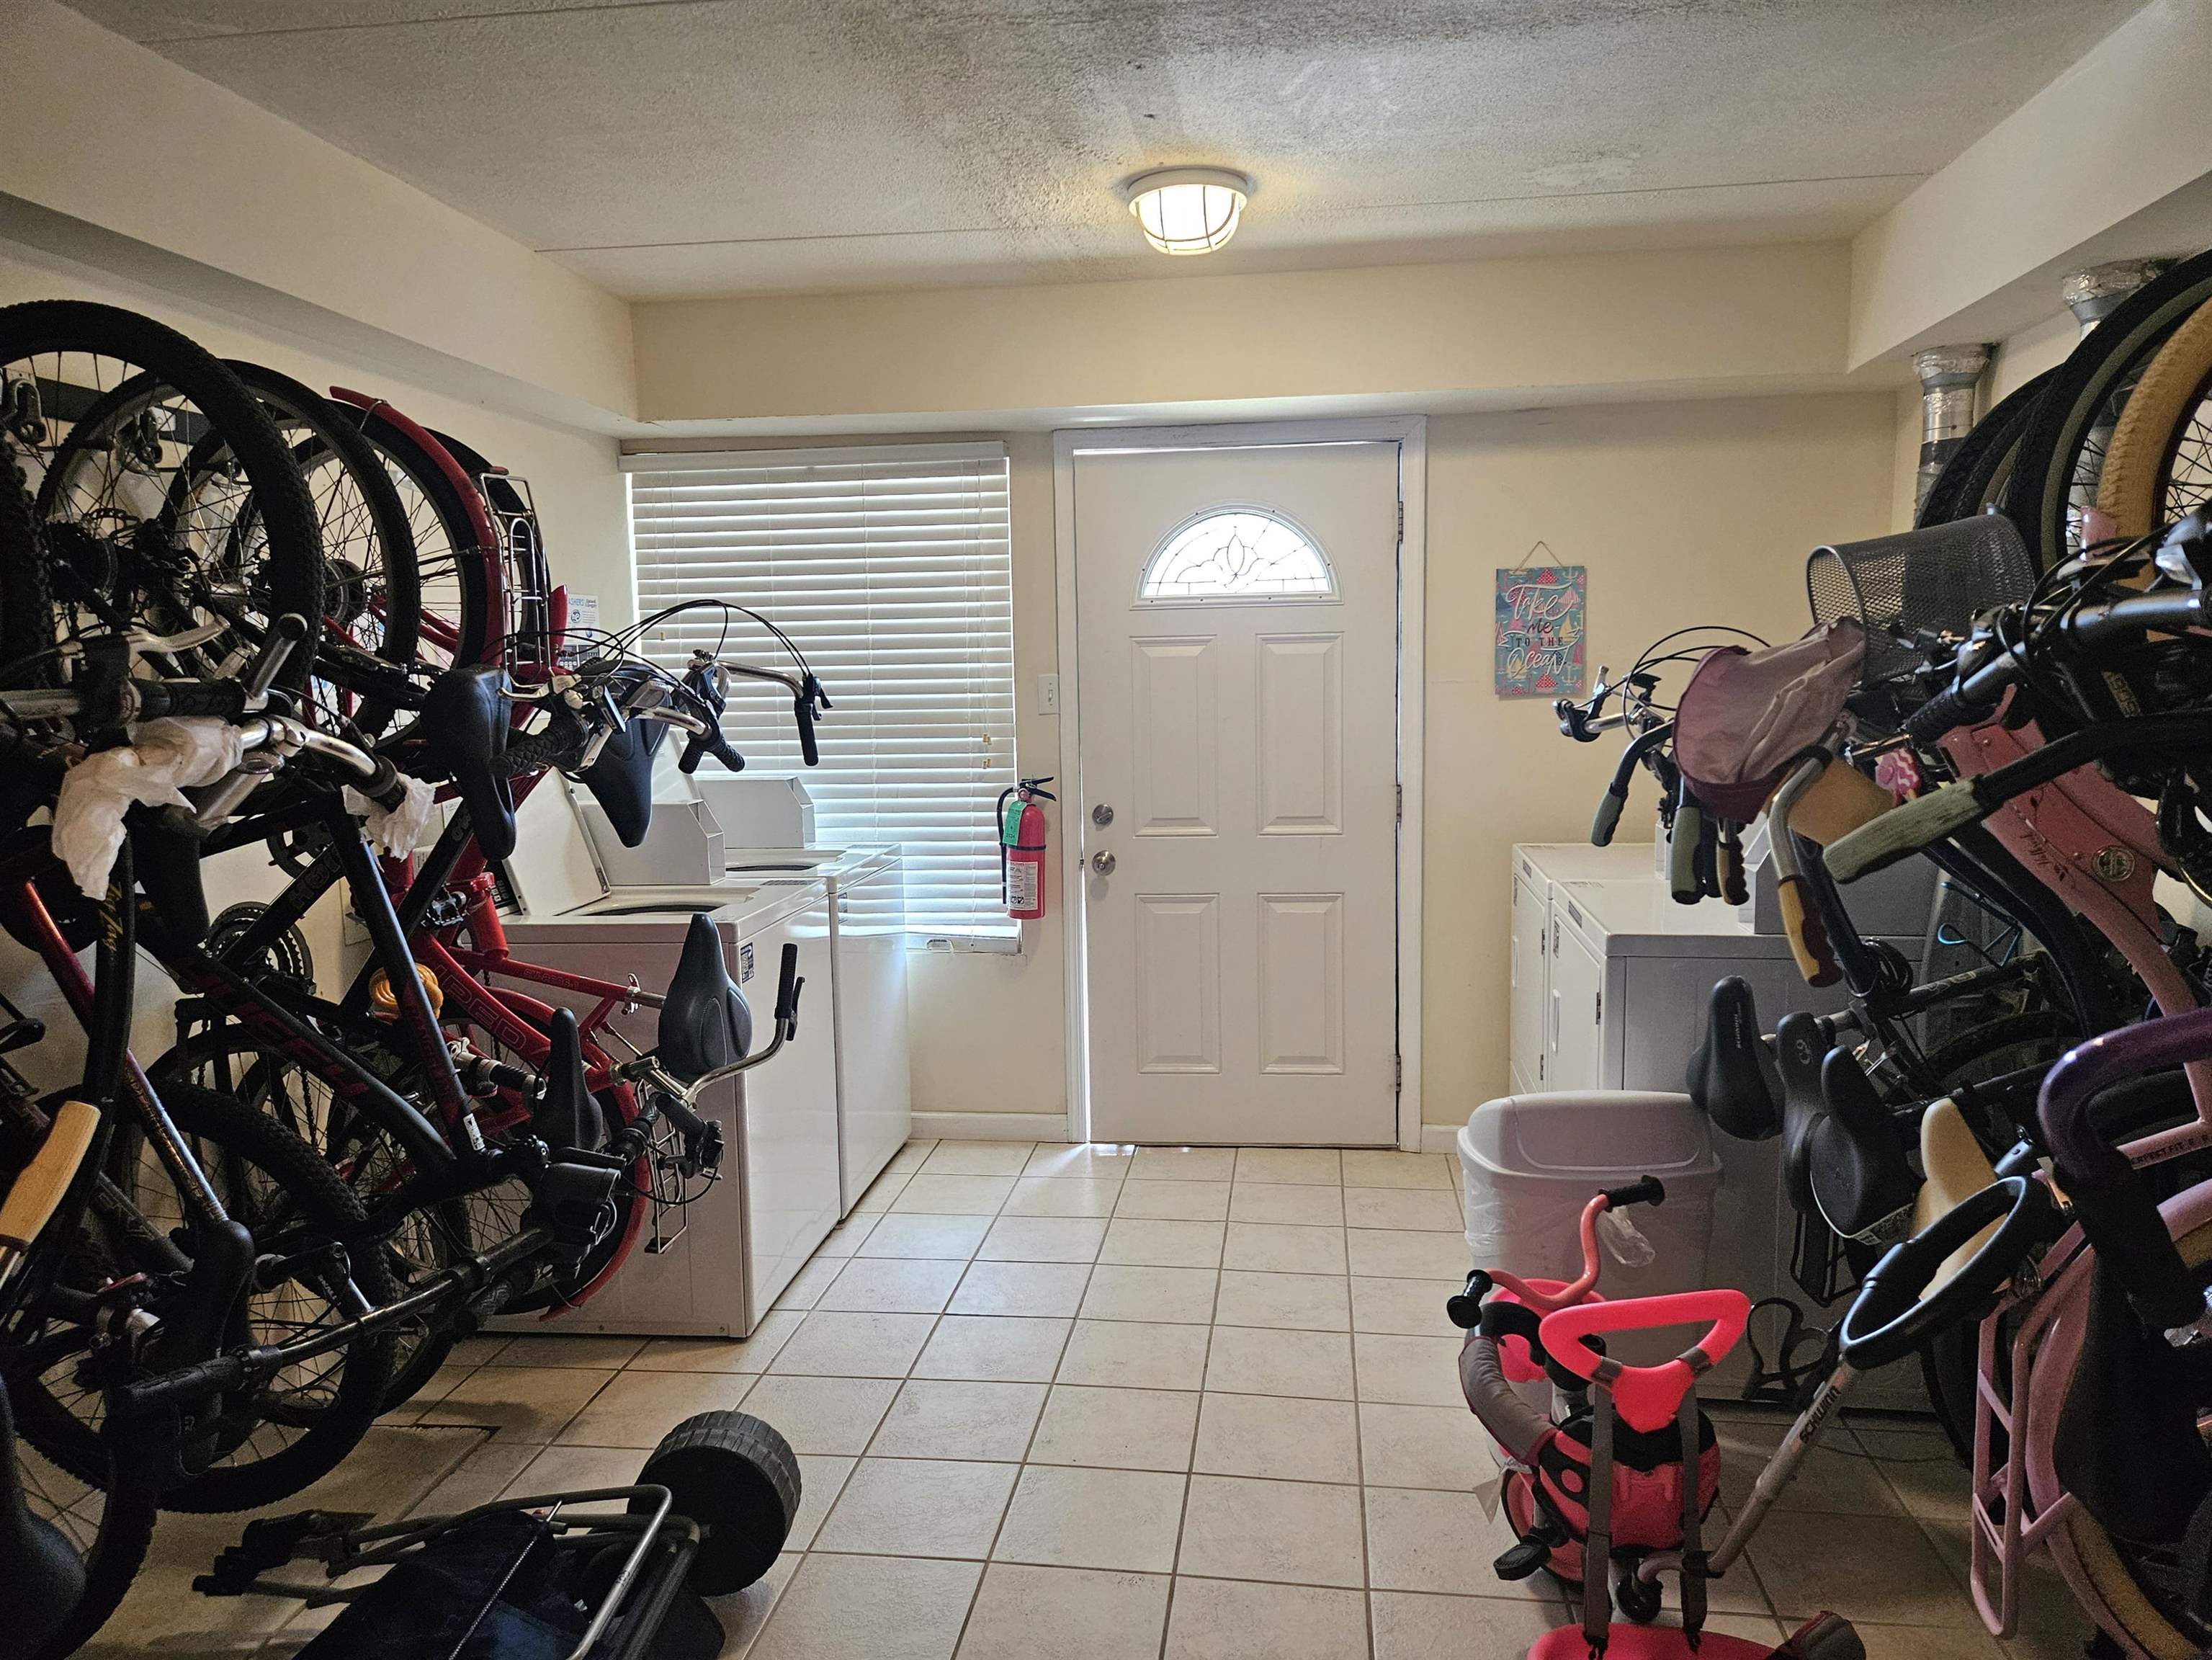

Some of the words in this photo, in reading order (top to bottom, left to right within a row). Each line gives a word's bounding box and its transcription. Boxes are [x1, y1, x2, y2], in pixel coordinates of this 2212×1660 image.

[1505, 581, 1574, 620] Take
[1515, 637, 1531, 647] TO
[1541, 636, 1564, 647] THE
